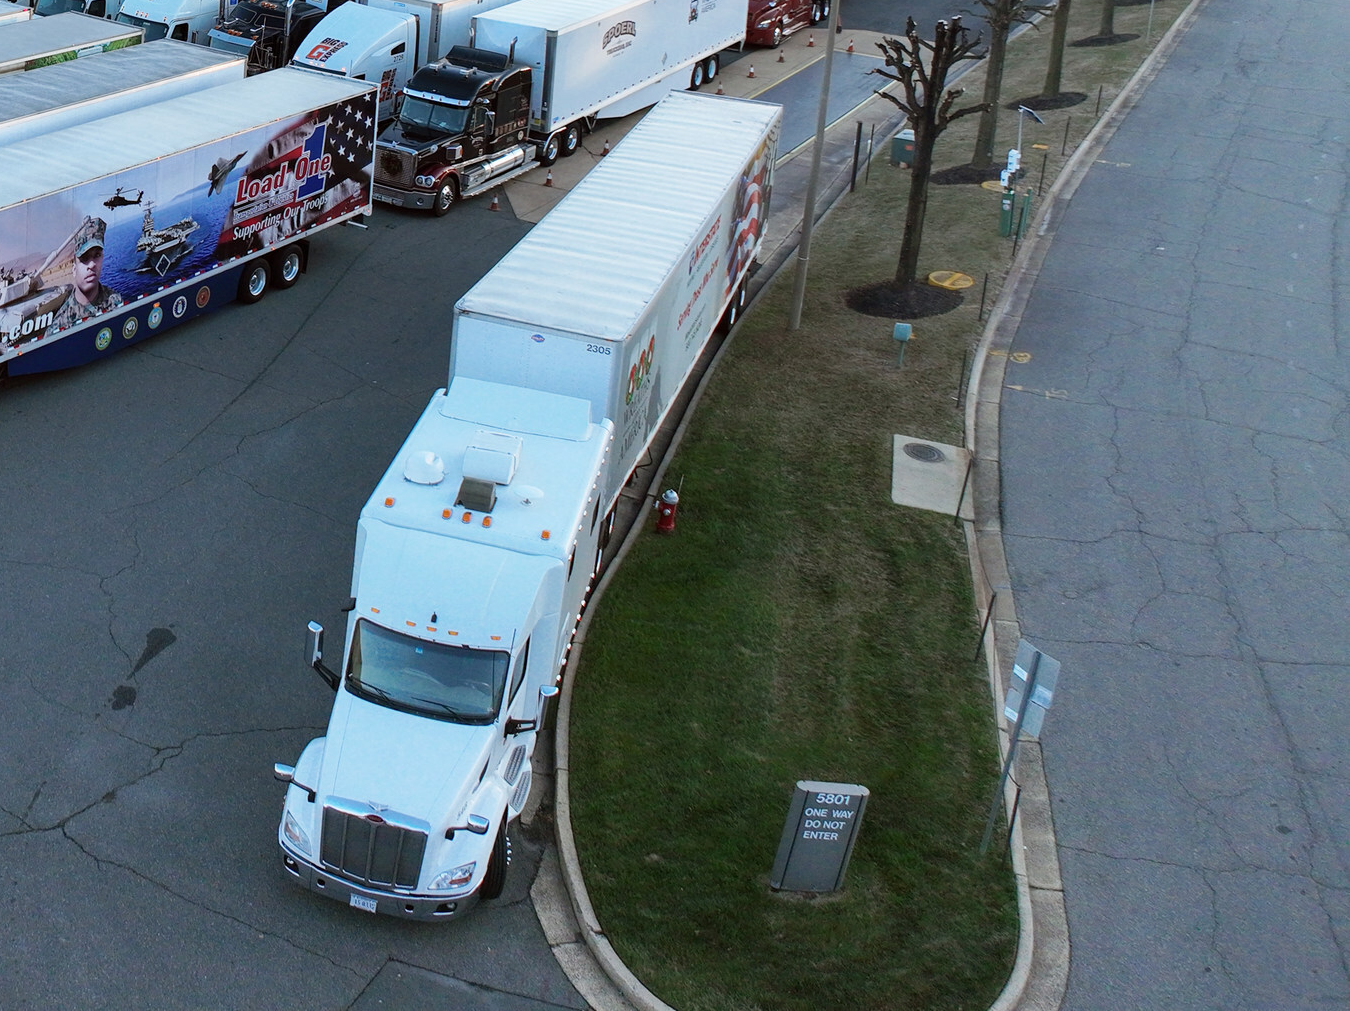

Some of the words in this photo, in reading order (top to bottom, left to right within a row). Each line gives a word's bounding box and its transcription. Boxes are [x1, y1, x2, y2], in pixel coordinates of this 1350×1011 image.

[602, 20, 636, 49] SPOERL
[306, 44, 331, 60] G
[234, 161, 289, 206] Load
[294, 153, 332, 182] One
[233, 213, 282, 241] Supporting
[283, 205, 301, 221] Our
[302, 194, 329, 211] Troops
[586, 343, 611, 356] 2305
[816, 793, 850, 805] 5801
[805, 808, 828, 817] ONE
[832, 809, 854, 819] WAY
[805, 819, 821, 828] DO
[822, 820, 846, 829] NOT
[803, 830, 839, 840] ENTER
